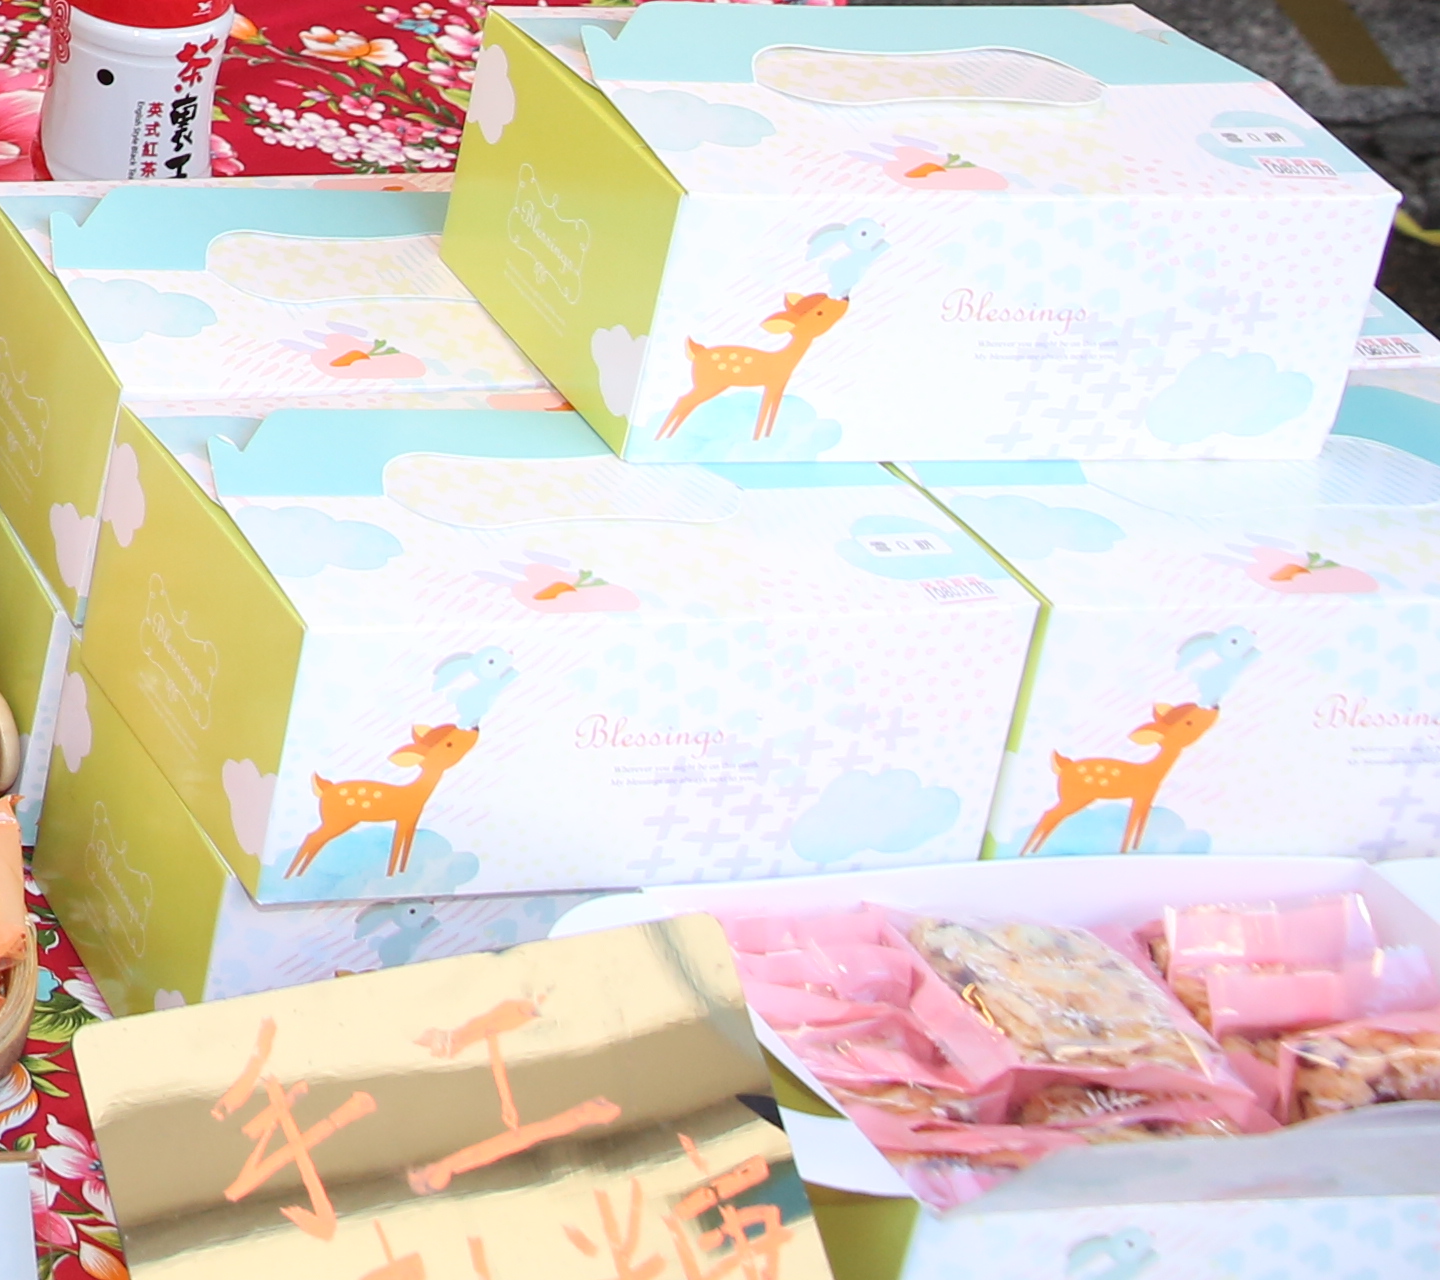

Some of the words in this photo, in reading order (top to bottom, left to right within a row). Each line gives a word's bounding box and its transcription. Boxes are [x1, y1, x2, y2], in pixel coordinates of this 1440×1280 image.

[140, 101, 164, 178] 英式紅茶
[940, 287, 1089, 336] Blessings
[574, 712, 725, 760] Blessings
